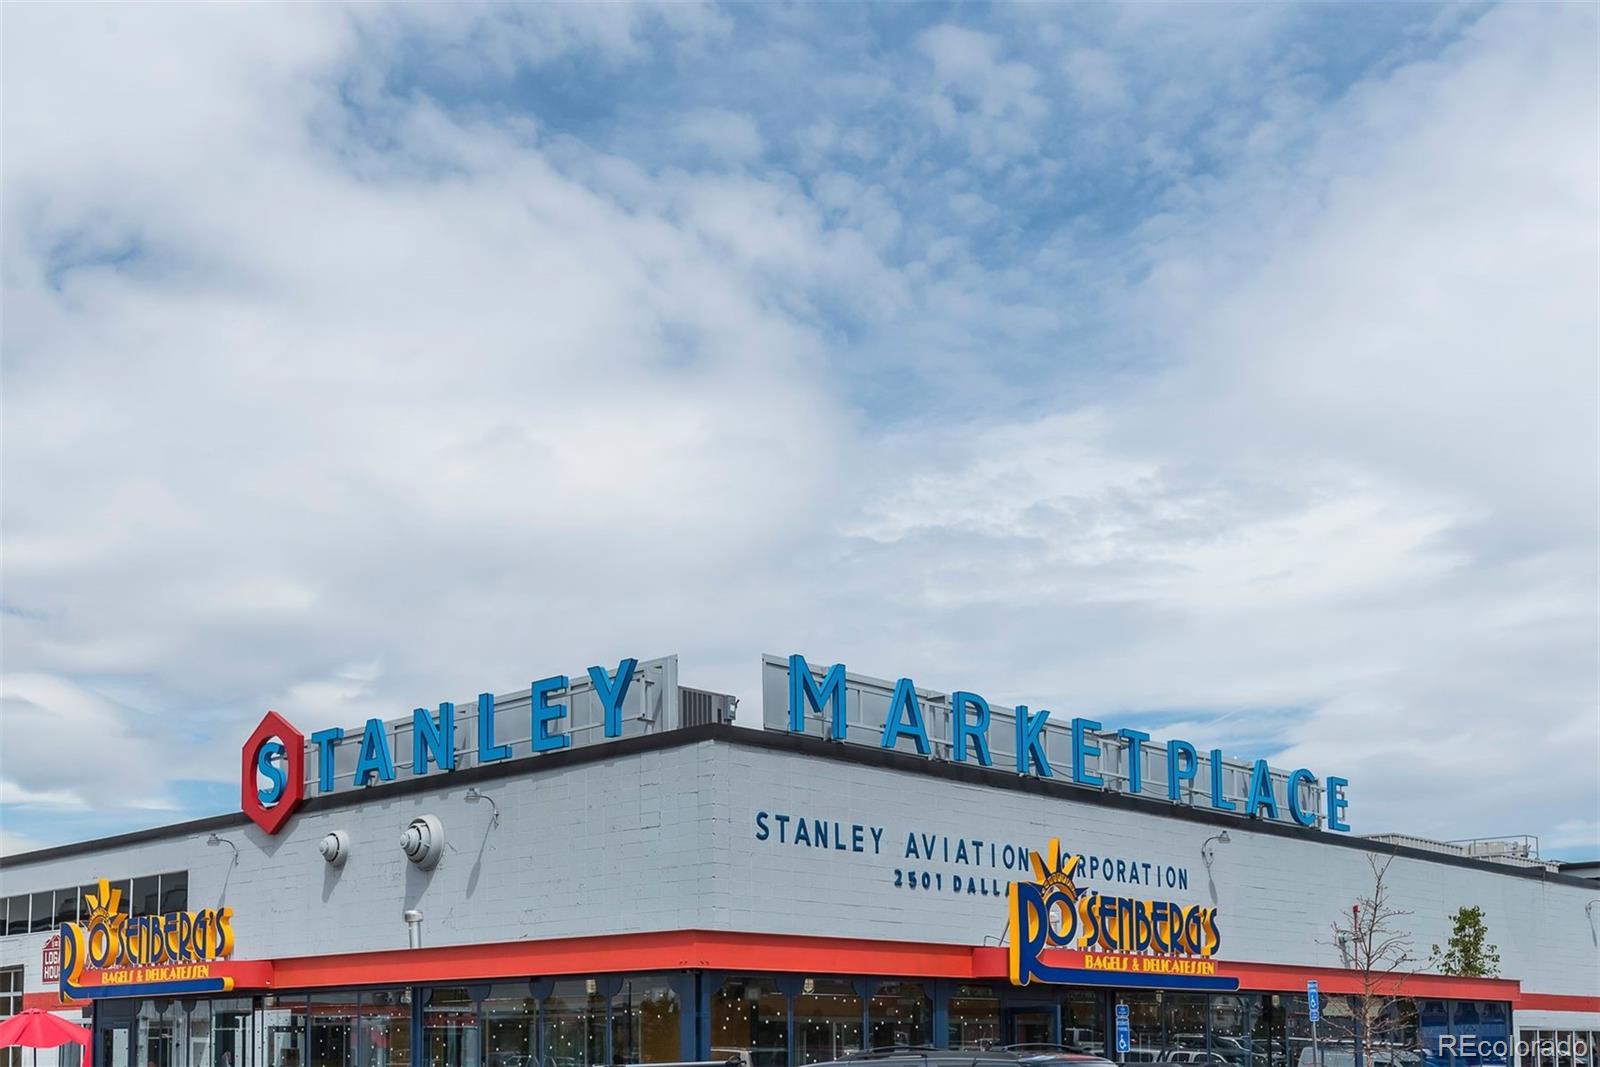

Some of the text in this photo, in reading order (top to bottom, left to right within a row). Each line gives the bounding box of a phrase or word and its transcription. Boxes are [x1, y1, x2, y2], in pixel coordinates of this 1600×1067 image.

[256, 658, 638, 804] STANLEY
[788, 653, 1350, 832] MARKETPLACE
[755, 811, 884, 854] STANLEY
[904, 832, 1029, 872] AVIATION
[1061, 851, 1188, 890] ORPORATION
[893, 869, 1009, 897] 2501 DALL
[101, 970, 134, 984] BAGELS
[146, 965, 209, 981] DELICATESSEN
[1085, 955, 1215, 975] BAGELS & DELICATESSEN
